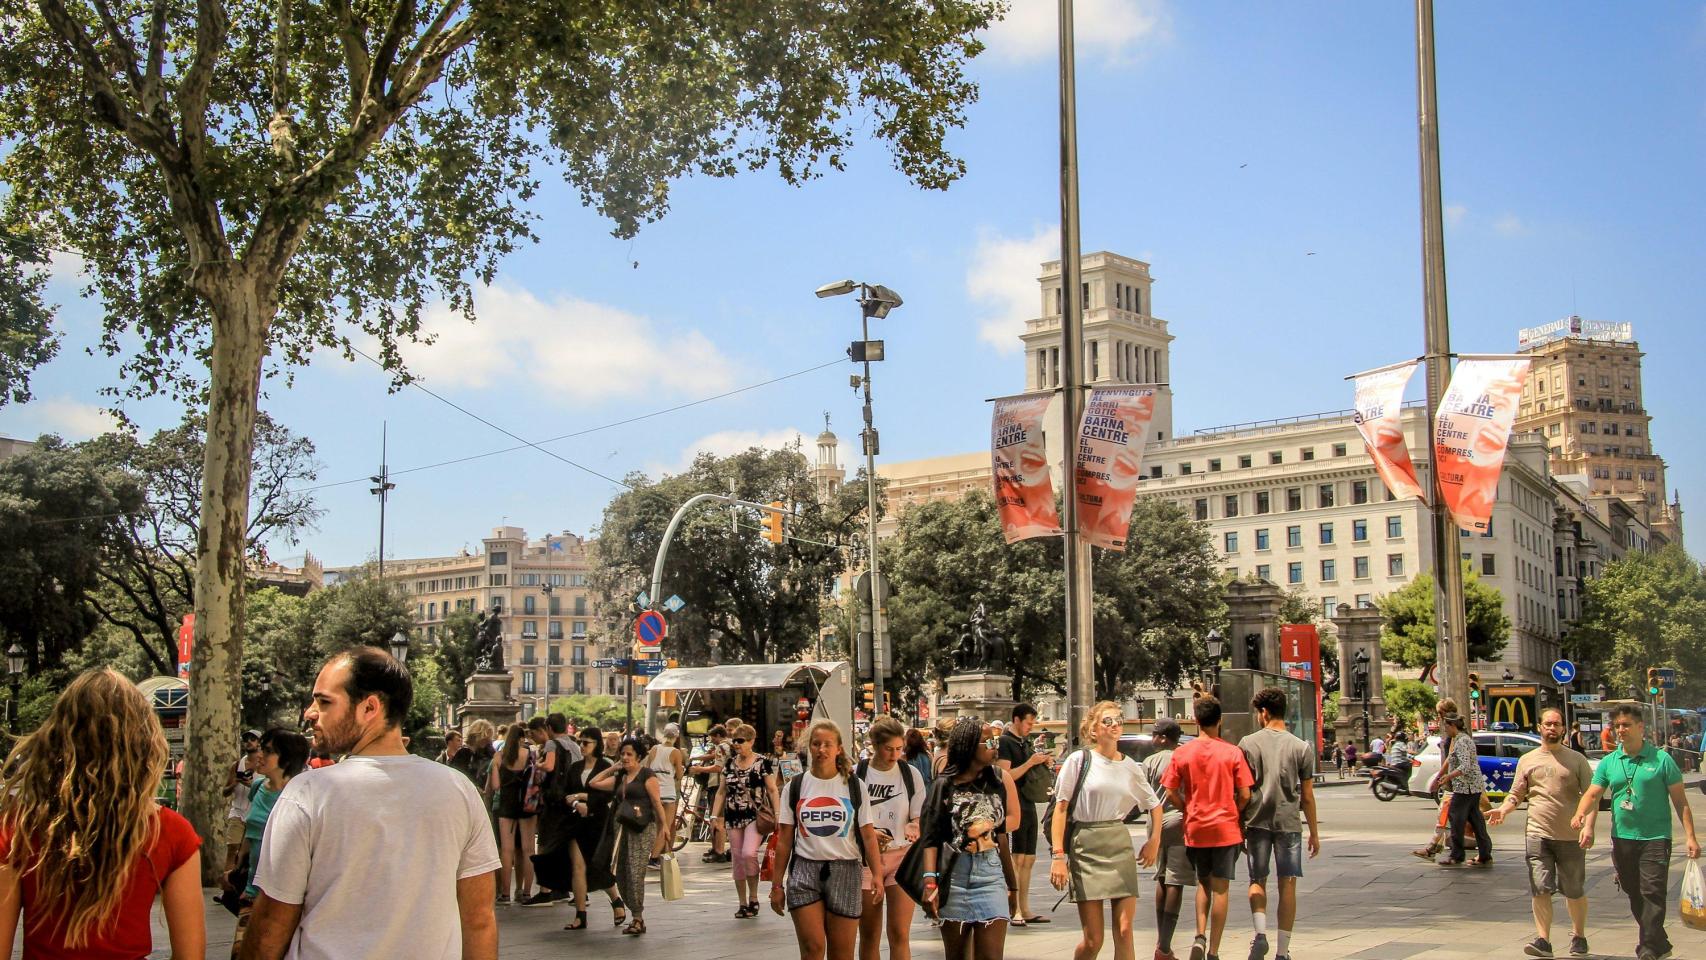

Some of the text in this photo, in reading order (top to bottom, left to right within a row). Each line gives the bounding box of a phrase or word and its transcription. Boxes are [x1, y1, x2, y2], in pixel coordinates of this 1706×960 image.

[1085, 416, 1124, 430] BARNA
[1439, 421, 1454, 429] TEU
[996, 431, 1027, 446] ENTRE
[1083, 425, 1129, 443] CENTRE
[1437, 429, 1468, 440] CENTRE
[1080, 438, 1089, 446] EL
[1080, 446, 1093, 454] TEU
[1078, 454, 1106, 464] CENTRE
[1292, 639, 1299, 657] i
[868, 783, 895, 799] NIKE
[801, 810, 846, 822] PEPSI
